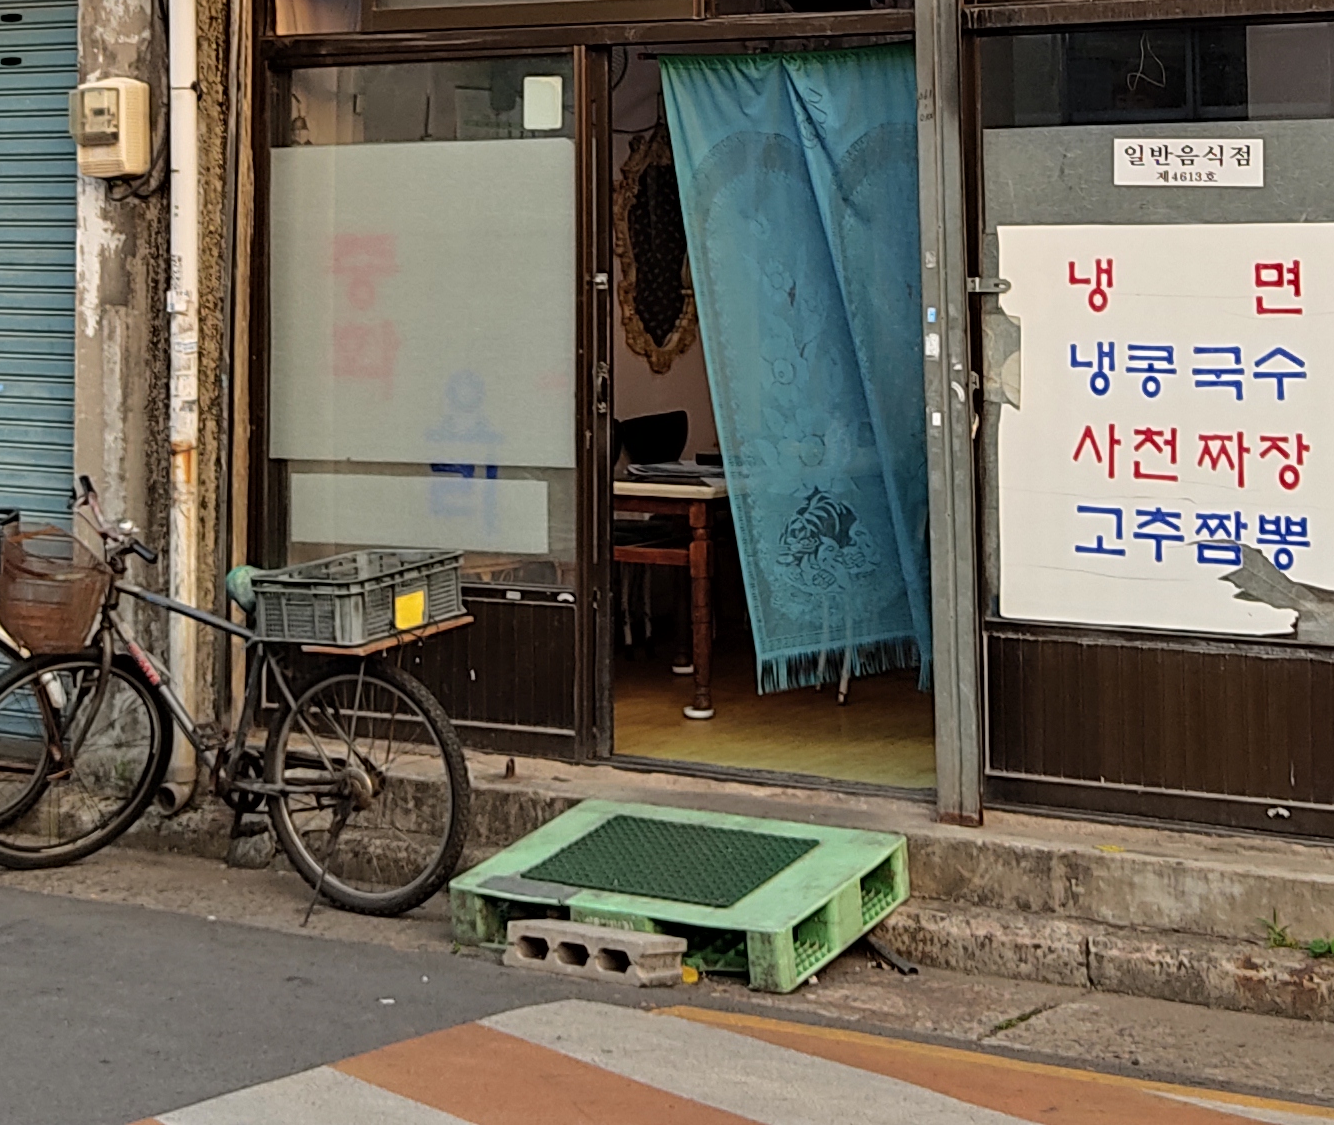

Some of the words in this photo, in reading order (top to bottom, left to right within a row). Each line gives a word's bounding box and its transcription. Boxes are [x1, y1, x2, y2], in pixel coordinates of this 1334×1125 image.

[1123, 143, 1252, 168] 일반음식점
[1069, 340, 1308, 401] 냉콩국수
[1072, 423, 1311, 491] 사천짜장
[1074, 504, 1312, 572] 고추짬뽕
